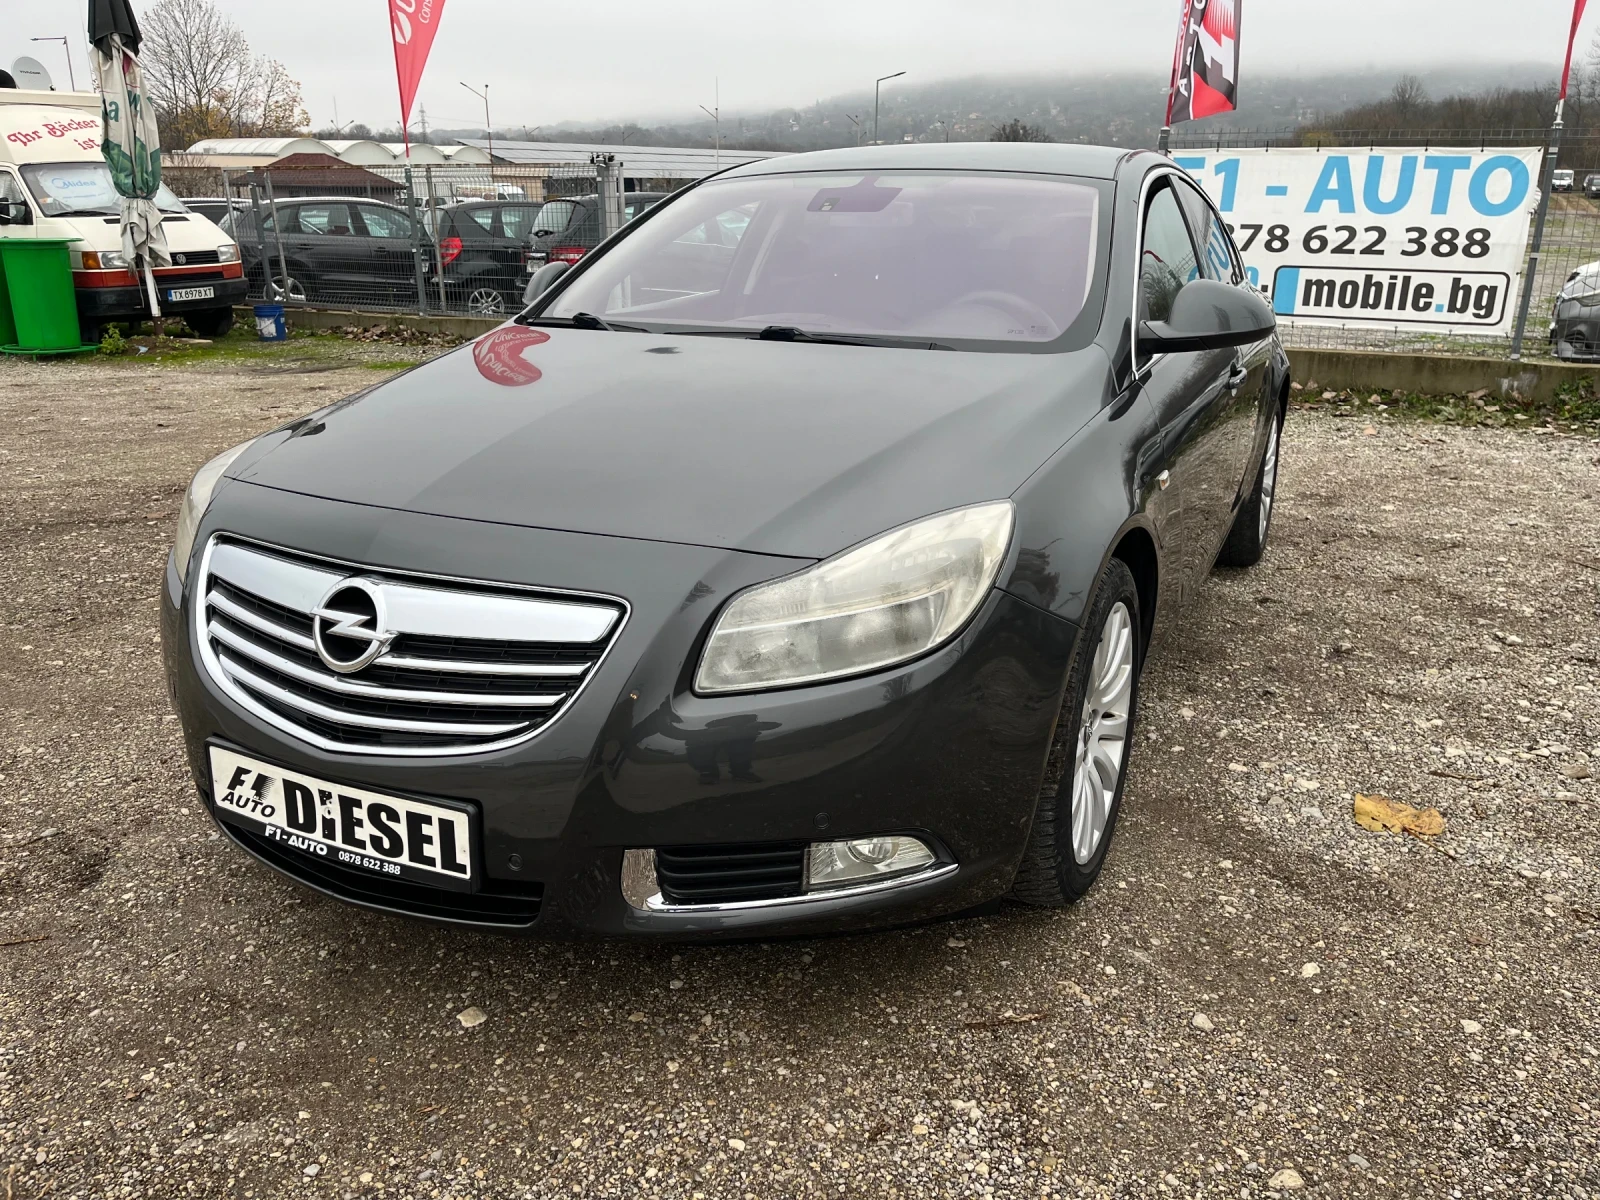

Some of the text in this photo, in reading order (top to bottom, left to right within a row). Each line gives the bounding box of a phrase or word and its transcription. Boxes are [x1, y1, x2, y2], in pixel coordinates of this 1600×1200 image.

[42, 119, 100, 138] Bäcker
[74, 138, 101, 151] ist
[1304, 155, 1530, 217] AUTO
[1302, 225, 1387, 255] 622
[1400, 226, 1491, 259] 388
[173, 288, 213, 300] TX 8978 XT
[1301, 274, 1499, 320] mobile.bg
[227, 766, 277, 801] F1
[220, 791, 276, 818] AUTO
[338, 851, 401, 875] 0878 622 388
